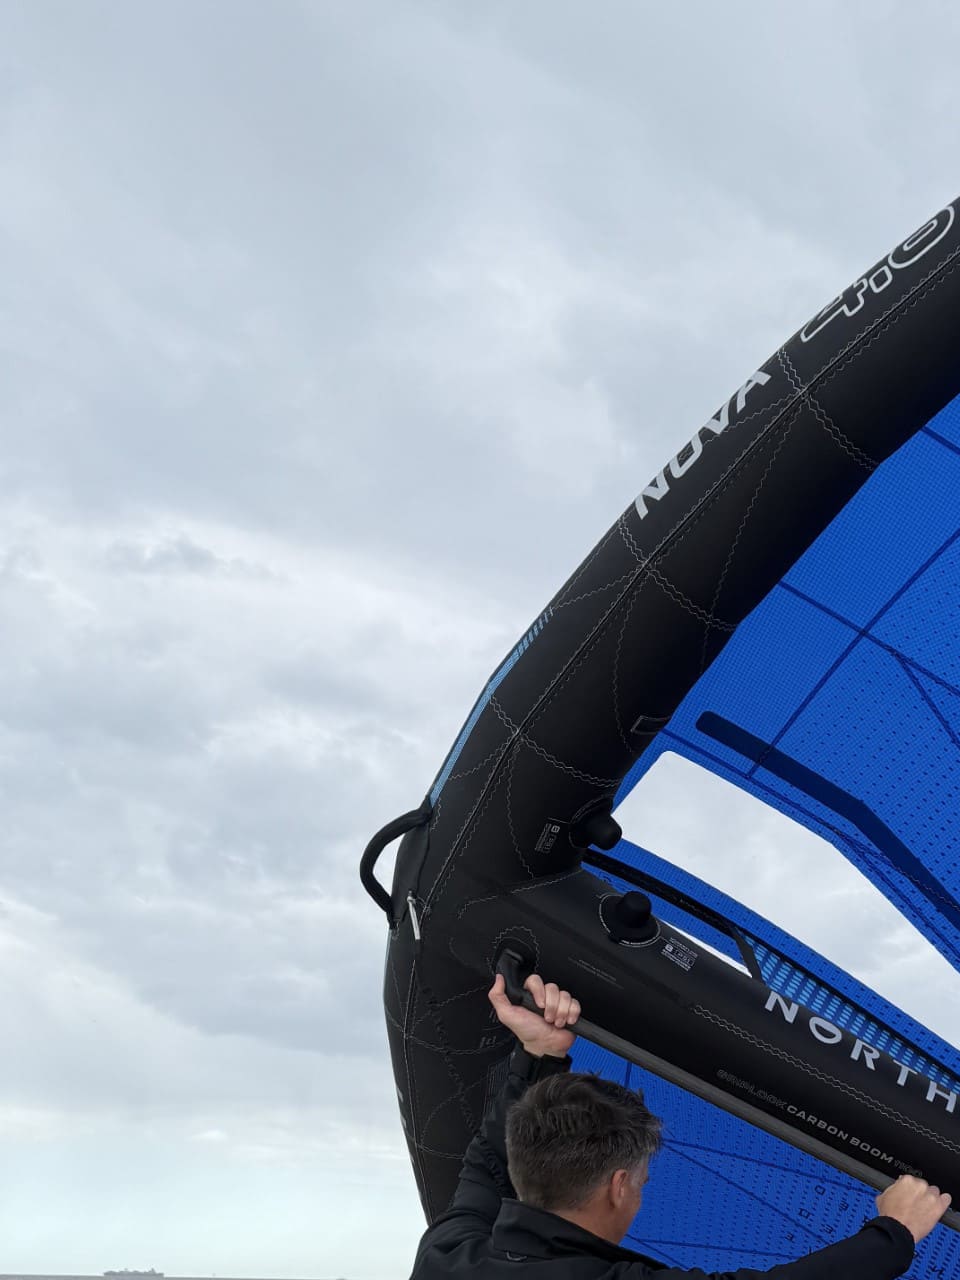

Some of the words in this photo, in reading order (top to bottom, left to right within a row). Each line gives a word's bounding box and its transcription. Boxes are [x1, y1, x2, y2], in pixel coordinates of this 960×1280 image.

[764, 991, 958, 1114] NORTH
[787, 1104, 849, 1143] CARBON
[849, 1136, 894, 1165] BOOM
